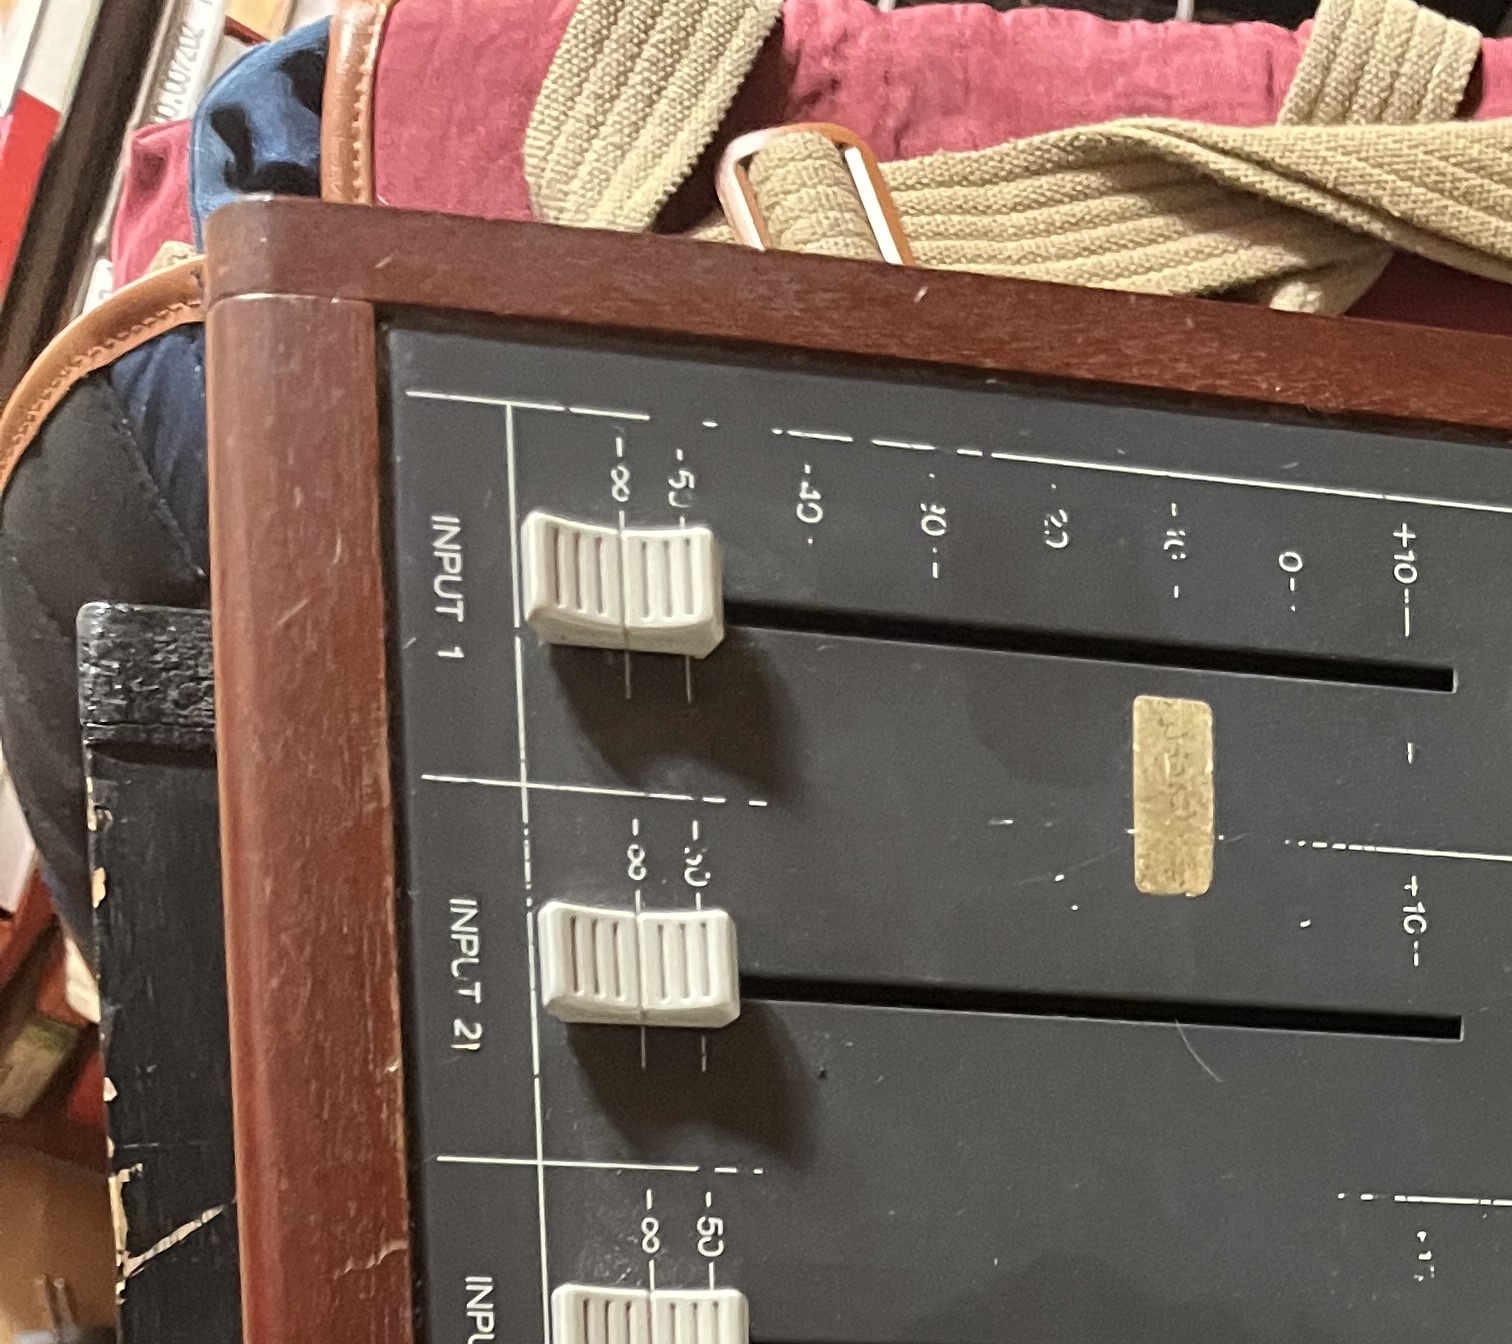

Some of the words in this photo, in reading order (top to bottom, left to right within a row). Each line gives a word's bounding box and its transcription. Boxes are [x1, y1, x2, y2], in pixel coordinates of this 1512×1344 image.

[432, 516, 464, 622] INPUT
[1279, 552, 1302, 572] 0
[1393, 523, 1417, 583] +10
[438, 647, 464, 658] 1
